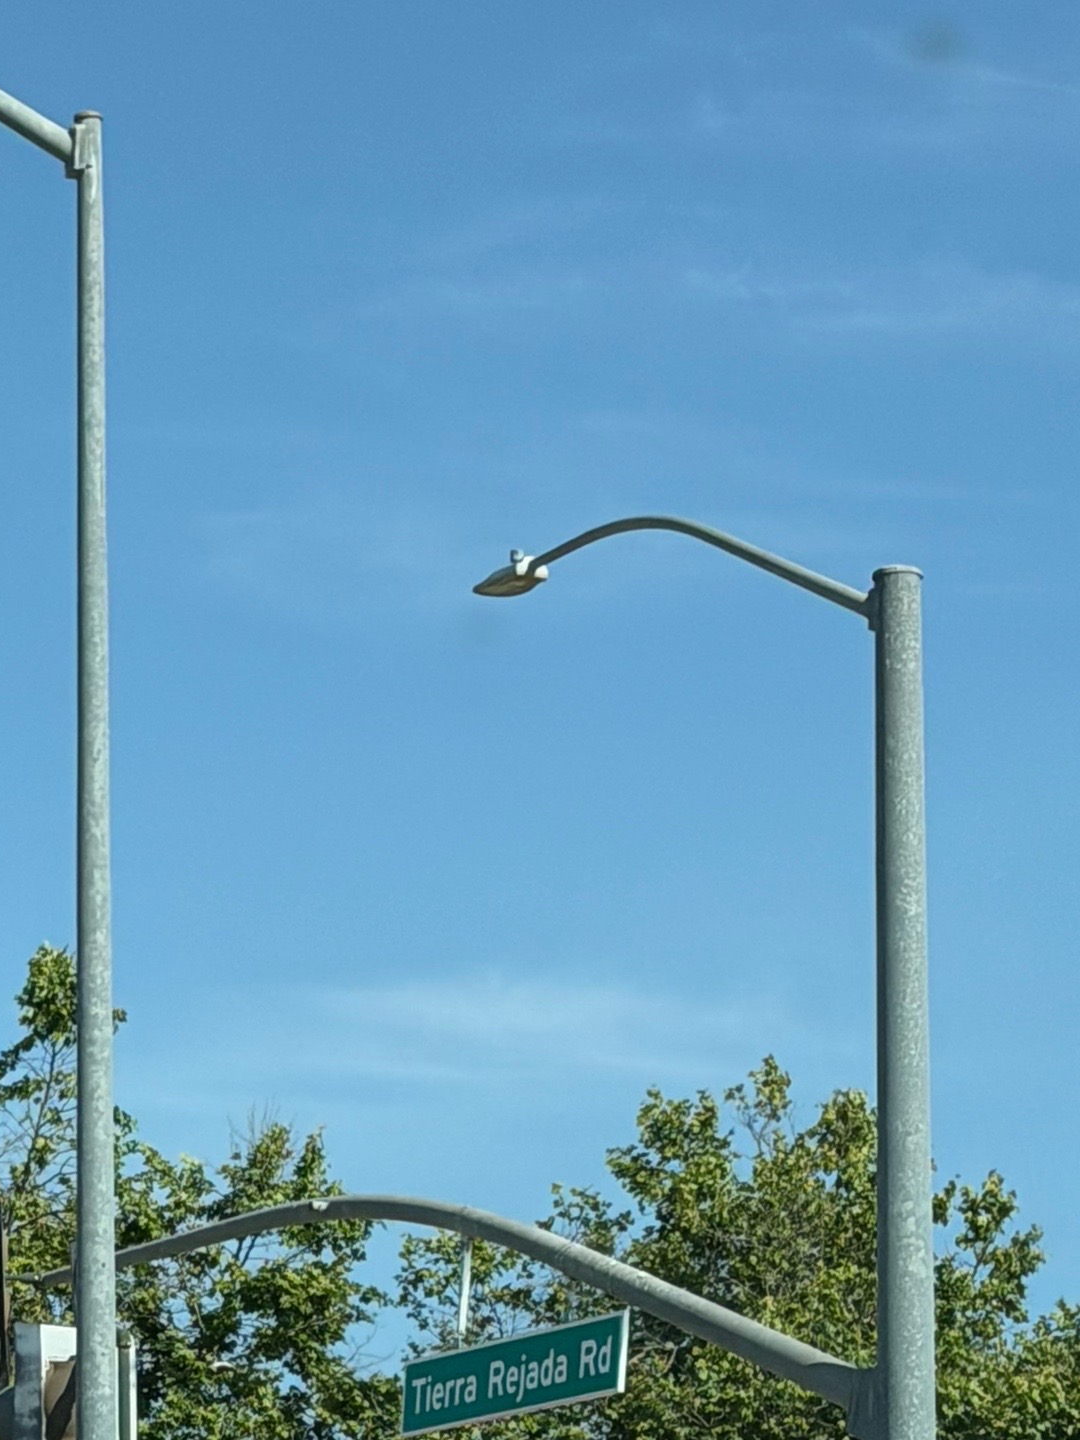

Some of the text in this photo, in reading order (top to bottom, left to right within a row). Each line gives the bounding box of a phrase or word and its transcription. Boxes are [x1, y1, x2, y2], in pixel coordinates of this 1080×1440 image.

[411, 1335, 613, 1415] Tierra Rejada Rd
